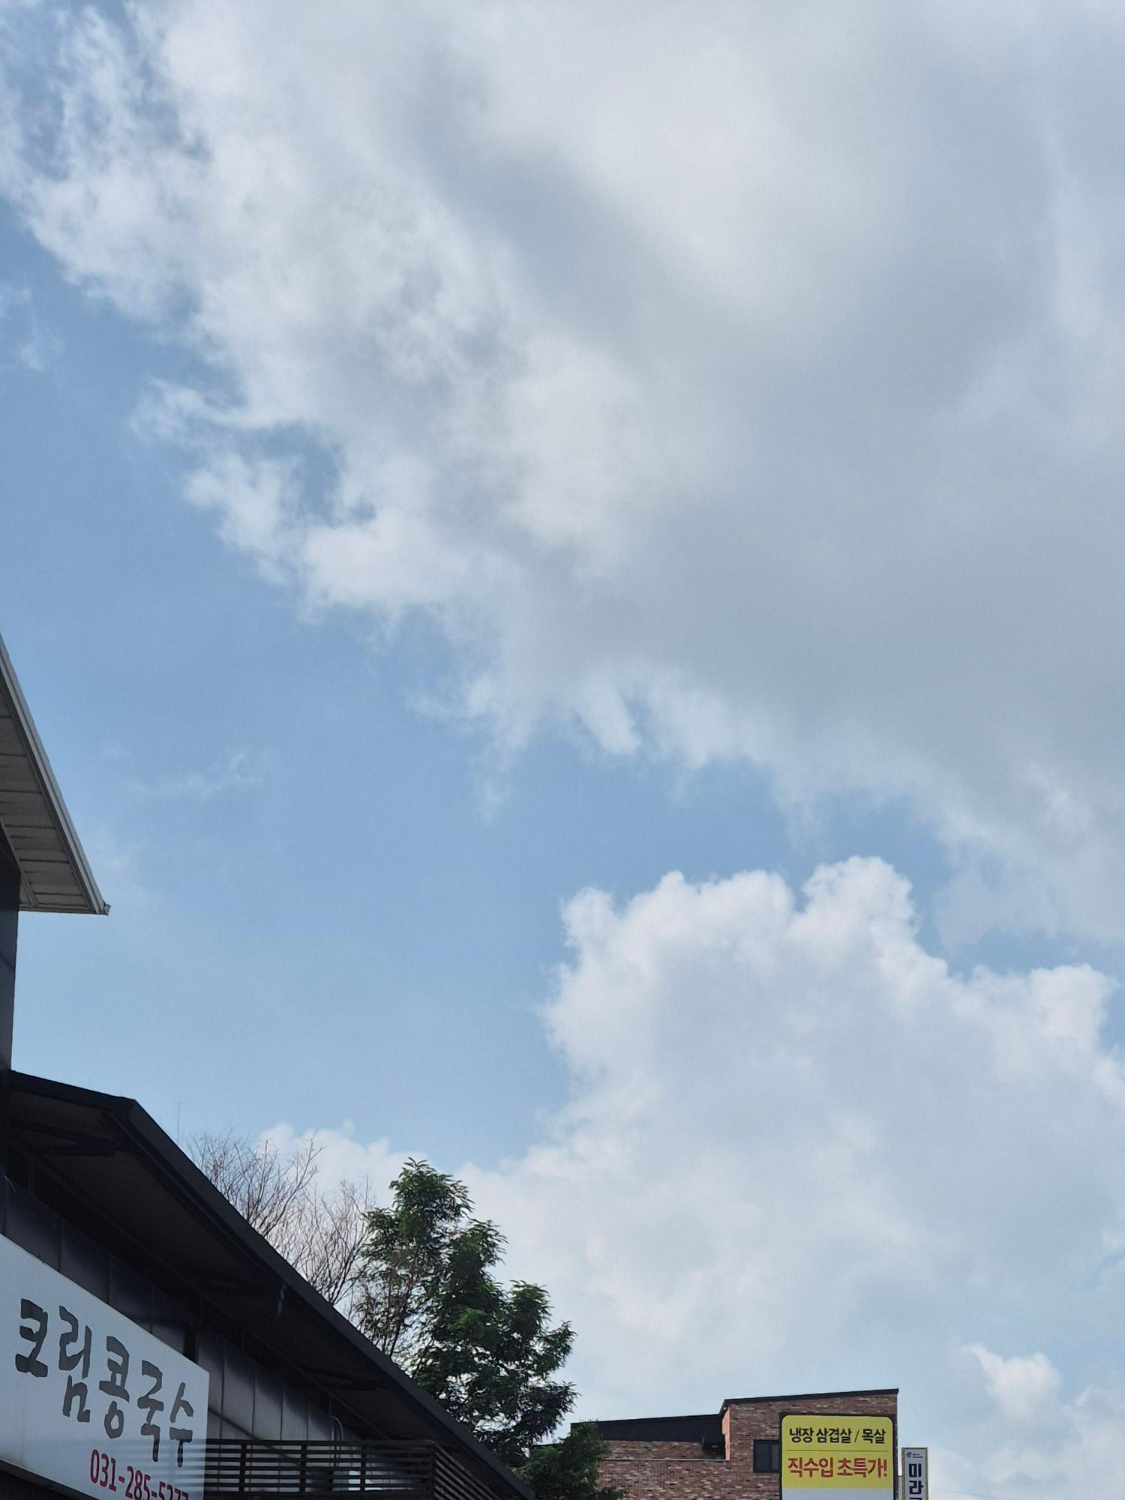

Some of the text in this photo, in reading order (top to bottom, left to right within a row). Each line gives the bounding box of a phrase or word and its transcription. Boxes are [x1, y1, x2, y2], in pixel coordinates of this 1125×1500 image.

[15, 1298, 195, 1468] 크림콩국수
[789, 1427, 814, 1443] 냉장
[816, 1427, 852, 1444] 삼겹살
[862, 1428, 886, 1444] 목살
[788, 1457, 888, 1479] 직수입 초특가!
